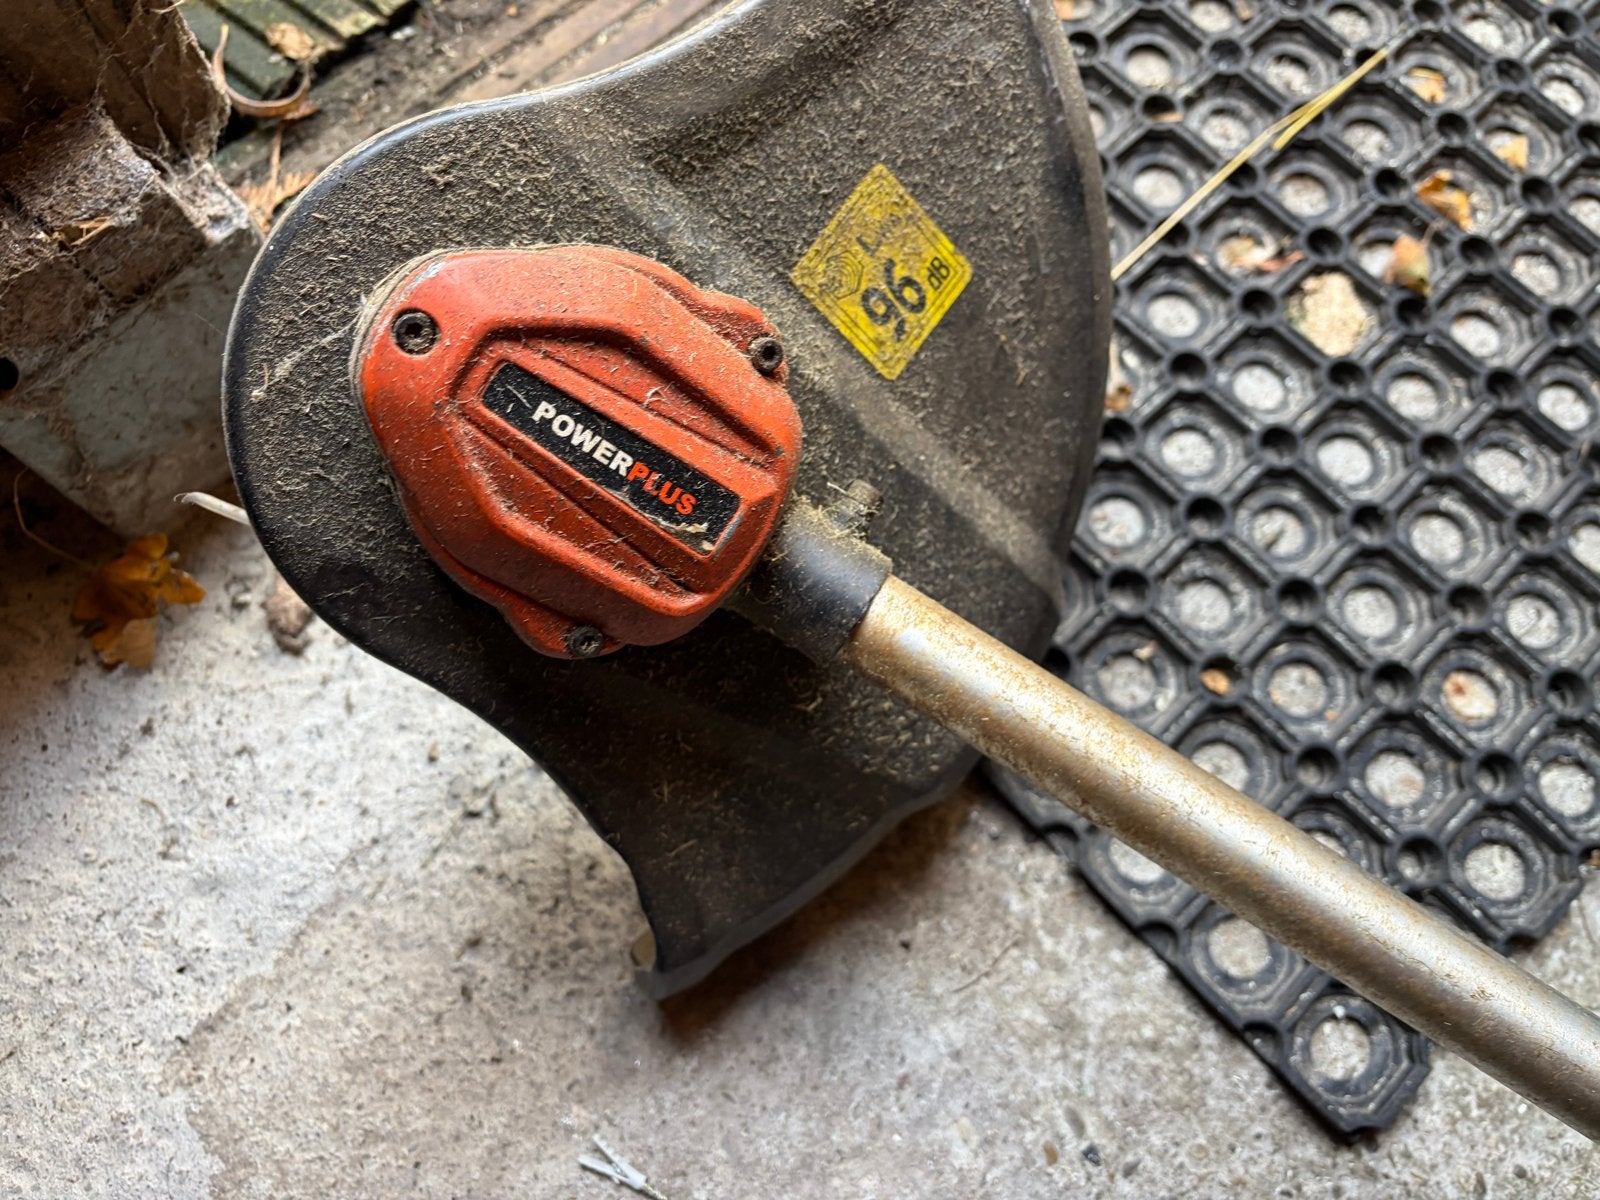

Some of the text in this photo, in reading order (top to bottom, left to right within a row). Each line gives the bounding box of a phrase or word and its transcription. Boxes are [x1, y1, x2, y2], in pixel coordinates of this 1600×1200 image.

[861, 256, 950, 342] 96 dB
[532, 401, 697, 515] POWERPLUS
